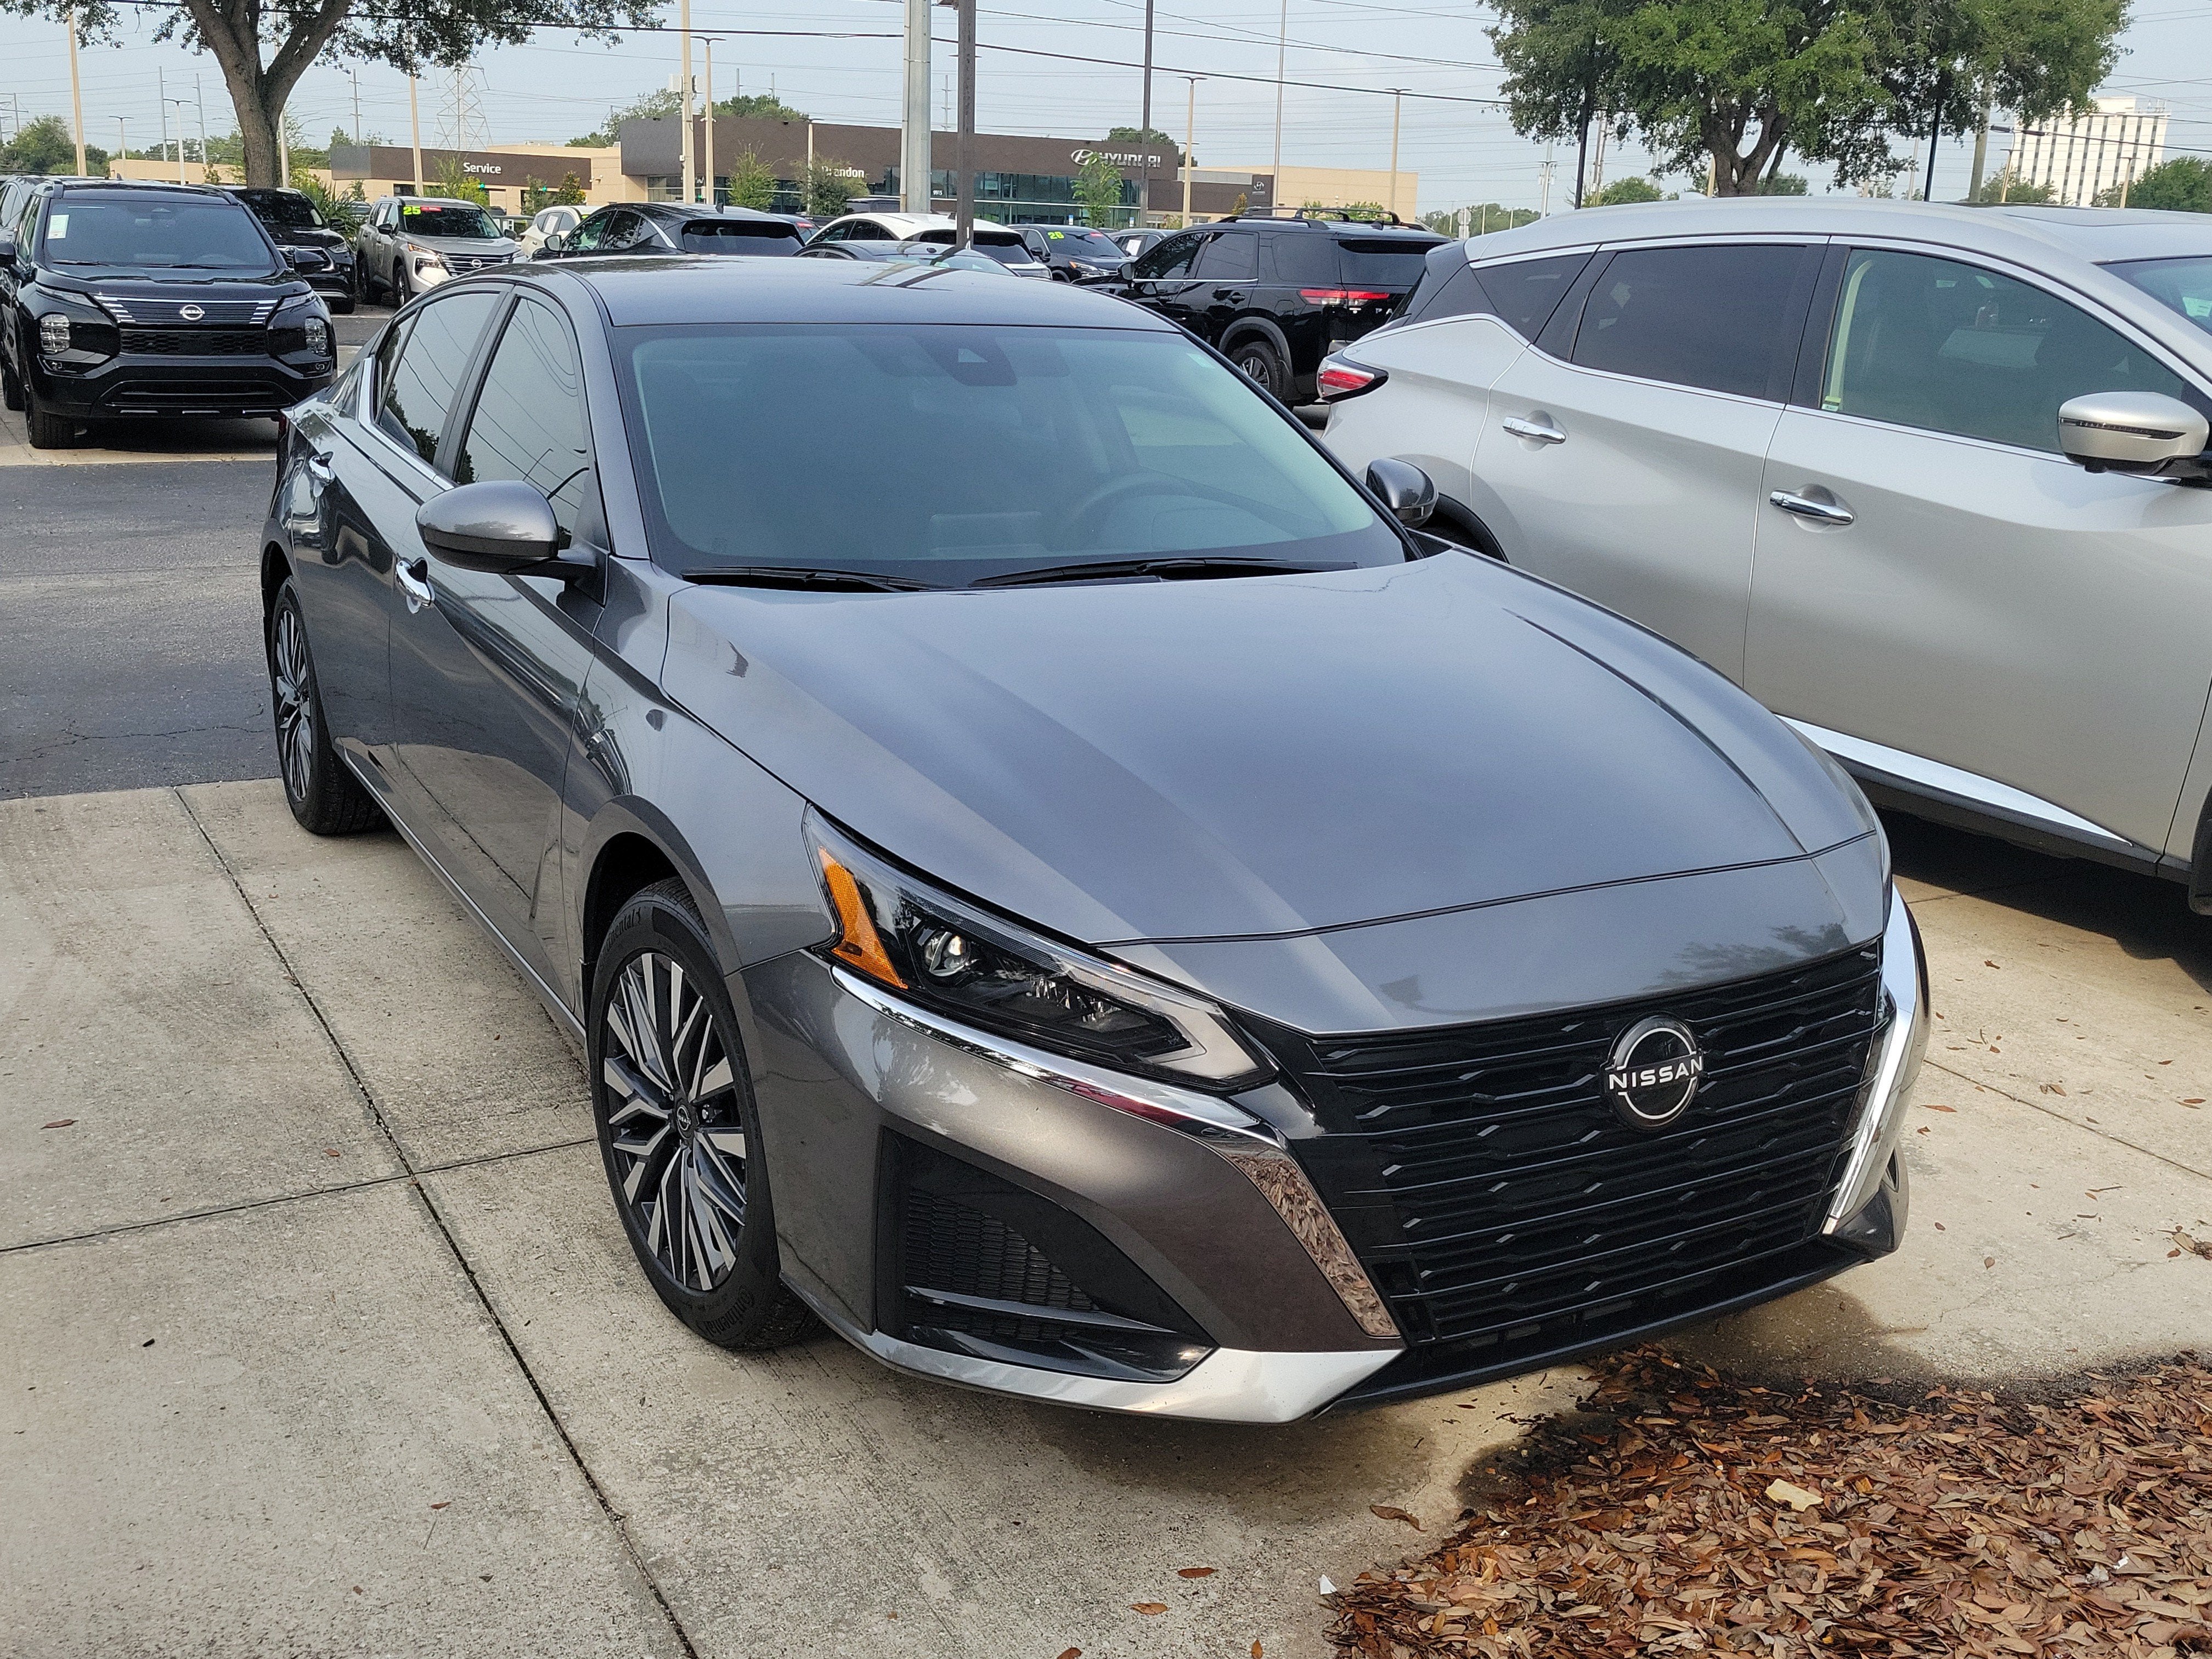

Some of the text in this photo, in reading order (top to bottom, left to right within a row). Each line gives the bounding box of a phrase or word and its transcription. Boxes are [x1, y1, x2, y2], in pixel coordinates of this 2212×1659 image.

[463, 162, 501, 174] Service
[403, 206, 421, 215] 25
[1609, 1056, 1702, 1090] NISSAN
